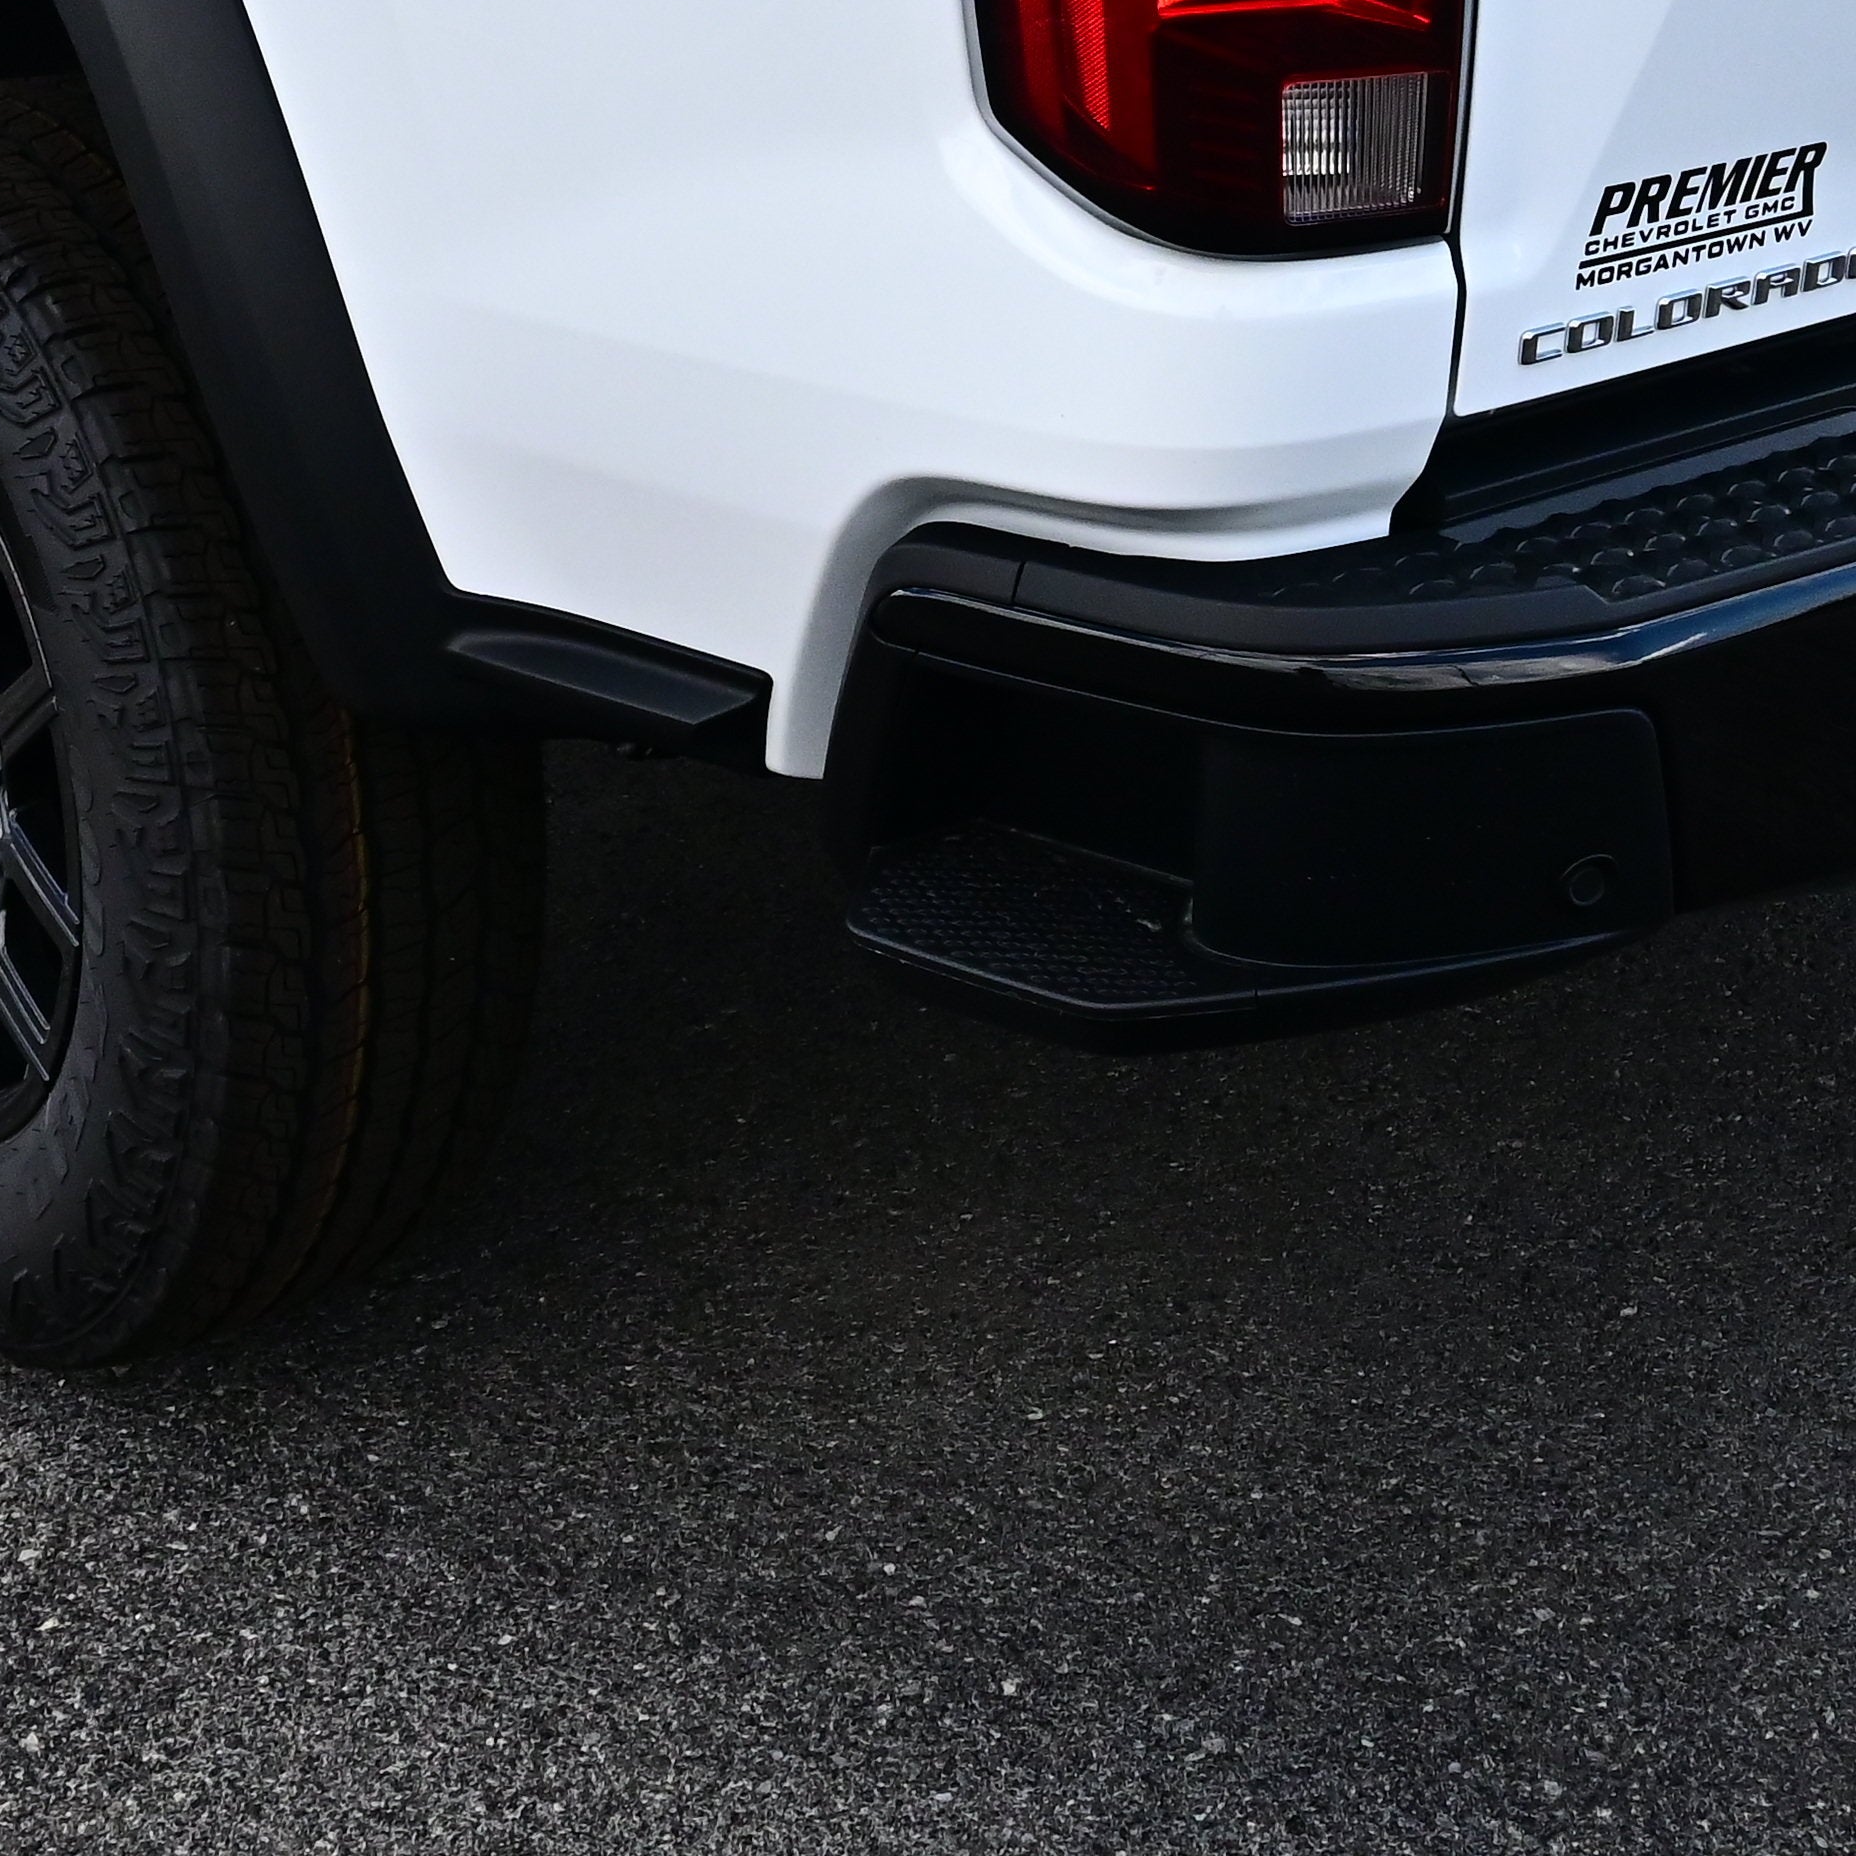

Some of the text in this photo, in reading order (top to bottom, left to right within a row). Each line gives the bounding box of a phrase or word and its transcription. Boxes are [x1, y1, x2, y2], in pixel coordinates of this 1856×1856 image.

[1588, 141, 1828, 236] PREMIER
[1575, 219, 1814, 291] MORGANTOWN WV
[1584, 195, 1796, 257] CHEVROLET GMC
